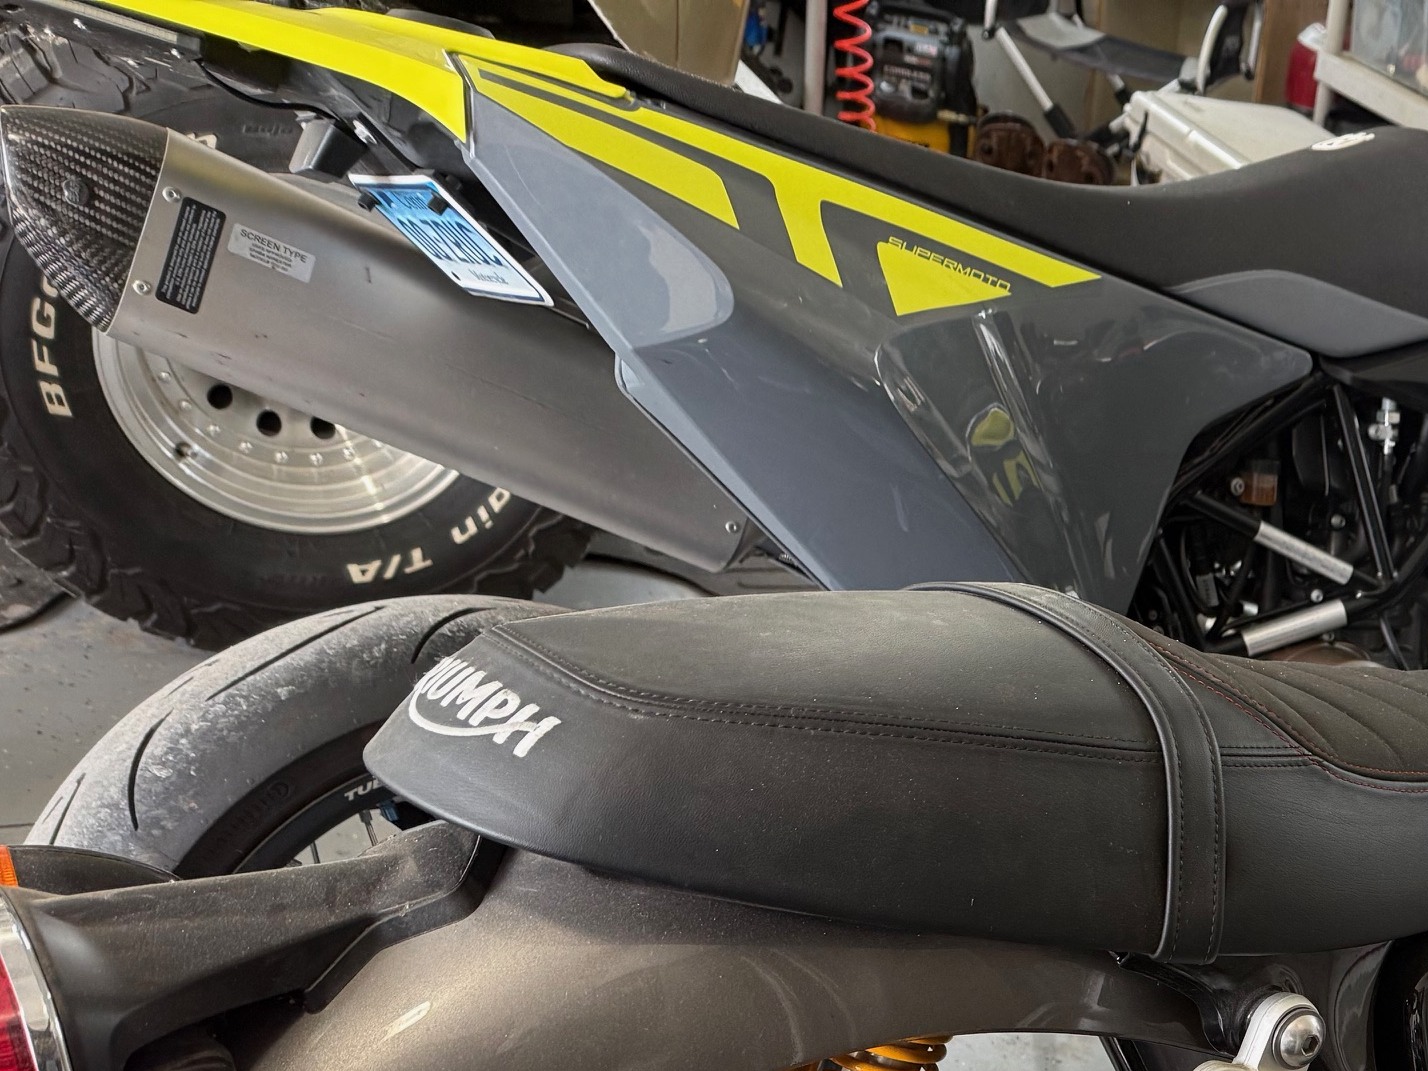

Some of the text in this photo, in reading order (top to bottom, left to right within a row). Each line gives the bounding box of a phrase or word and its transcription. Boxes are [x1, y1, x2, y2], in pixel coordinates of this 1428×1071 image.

[240, 228, 281, 252] SCREEN
[282, 244, 308, 264] TYPE
[888, 235, 1011, 292] SUPERMOTO
[346, 547, 434, 584] T/A
